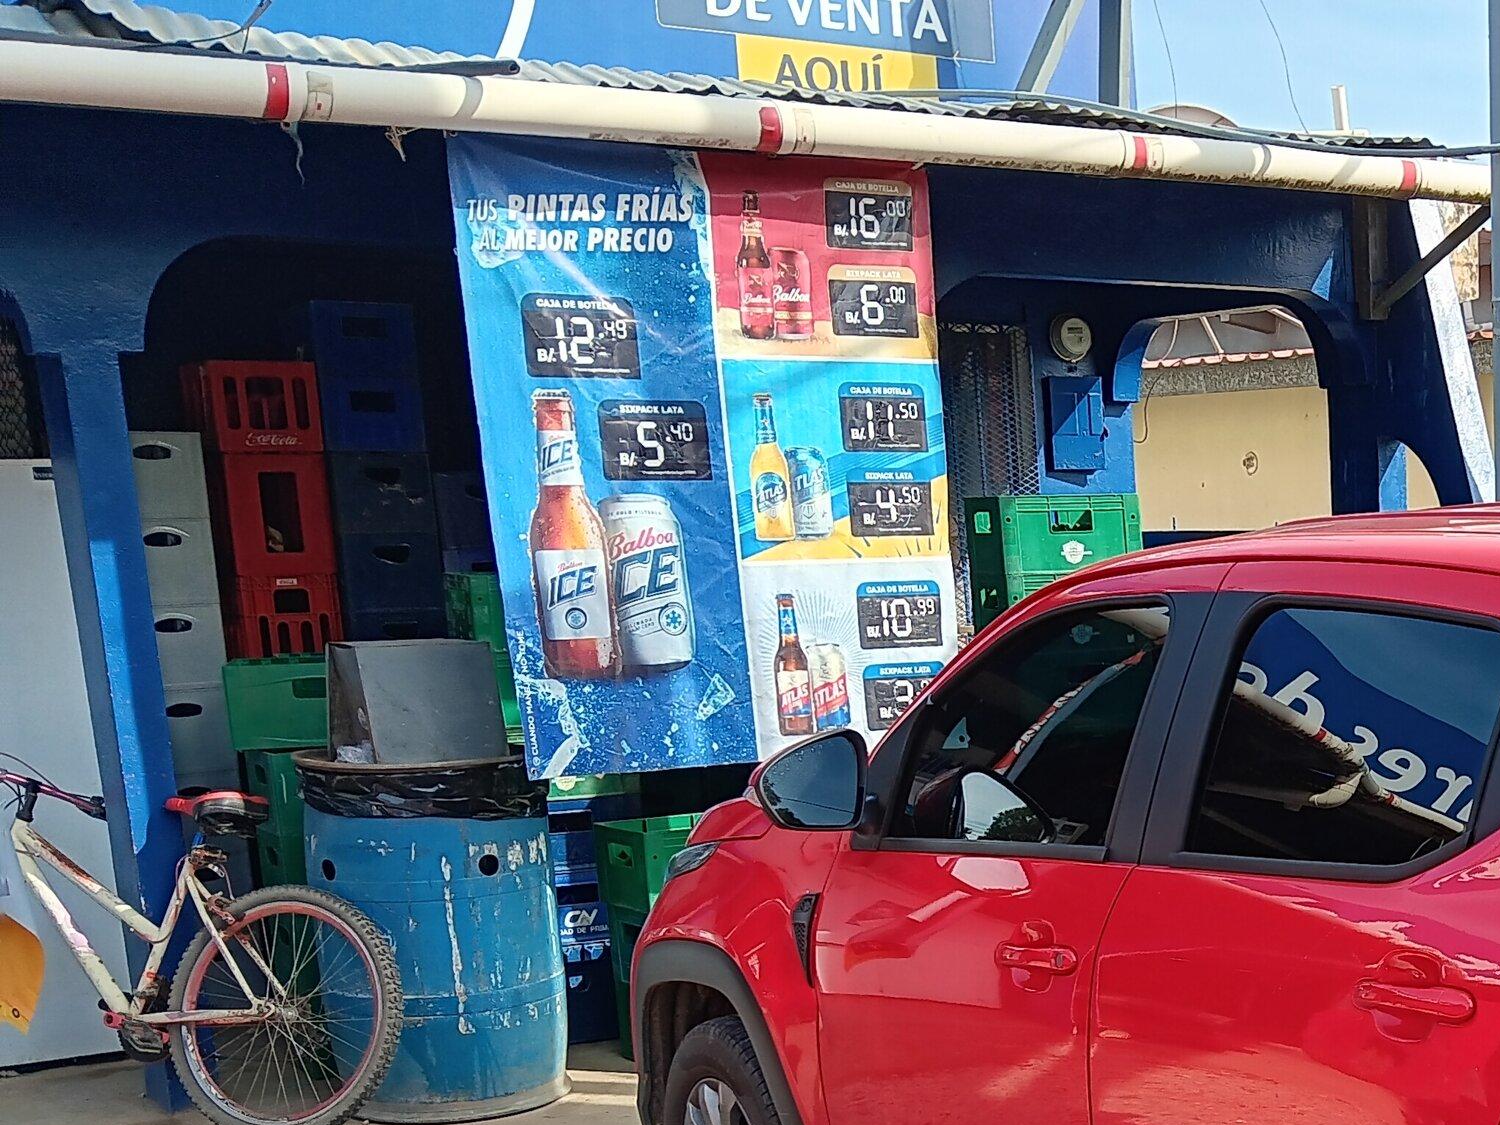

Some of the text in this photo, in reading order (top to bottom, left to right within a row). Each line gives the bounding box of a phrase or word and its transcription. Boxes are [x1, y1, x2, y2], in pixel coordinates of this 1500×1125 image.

[792, 0, 948, 42] VENTA
[775, 53, 883, 92] AQUÍ
[835, 181, 856, 191] CAJA
[868, 184, 899, 193] BOTELLA
[467, 186, 694, 222] TUS PINTAS FRÍAS
[480, 227, 674, 253] AL MEJOR PRECIO
[882, 271, 901, 279] LATA
[536, 299, 562, 309] CAJA
[562, 300, 576, 309] DE
[849, 386, 871, 394] CAJA
[882, 387, 912, 395] BOTELLA
[619, 405, 684, 414] SIXPACK LATA
[794, 467, 826, 491] TLAS
[865, 472, 914, 480] SIXPACK LATA
[608, 527, 675, 561] Balboa
[548, 566, 598, 609] ICE
[615, 545, 679, 606] CE
[887, 585, 897, 593] DE
[898, 584, 929, 592] BOTELLA
[516, 629, 527, 656] TOME
[879, 666, 931, 675] SIXPACK LATA
[521, 675, 534, 715] MANEJ
[527, 715, 540, 756] CUANDO
